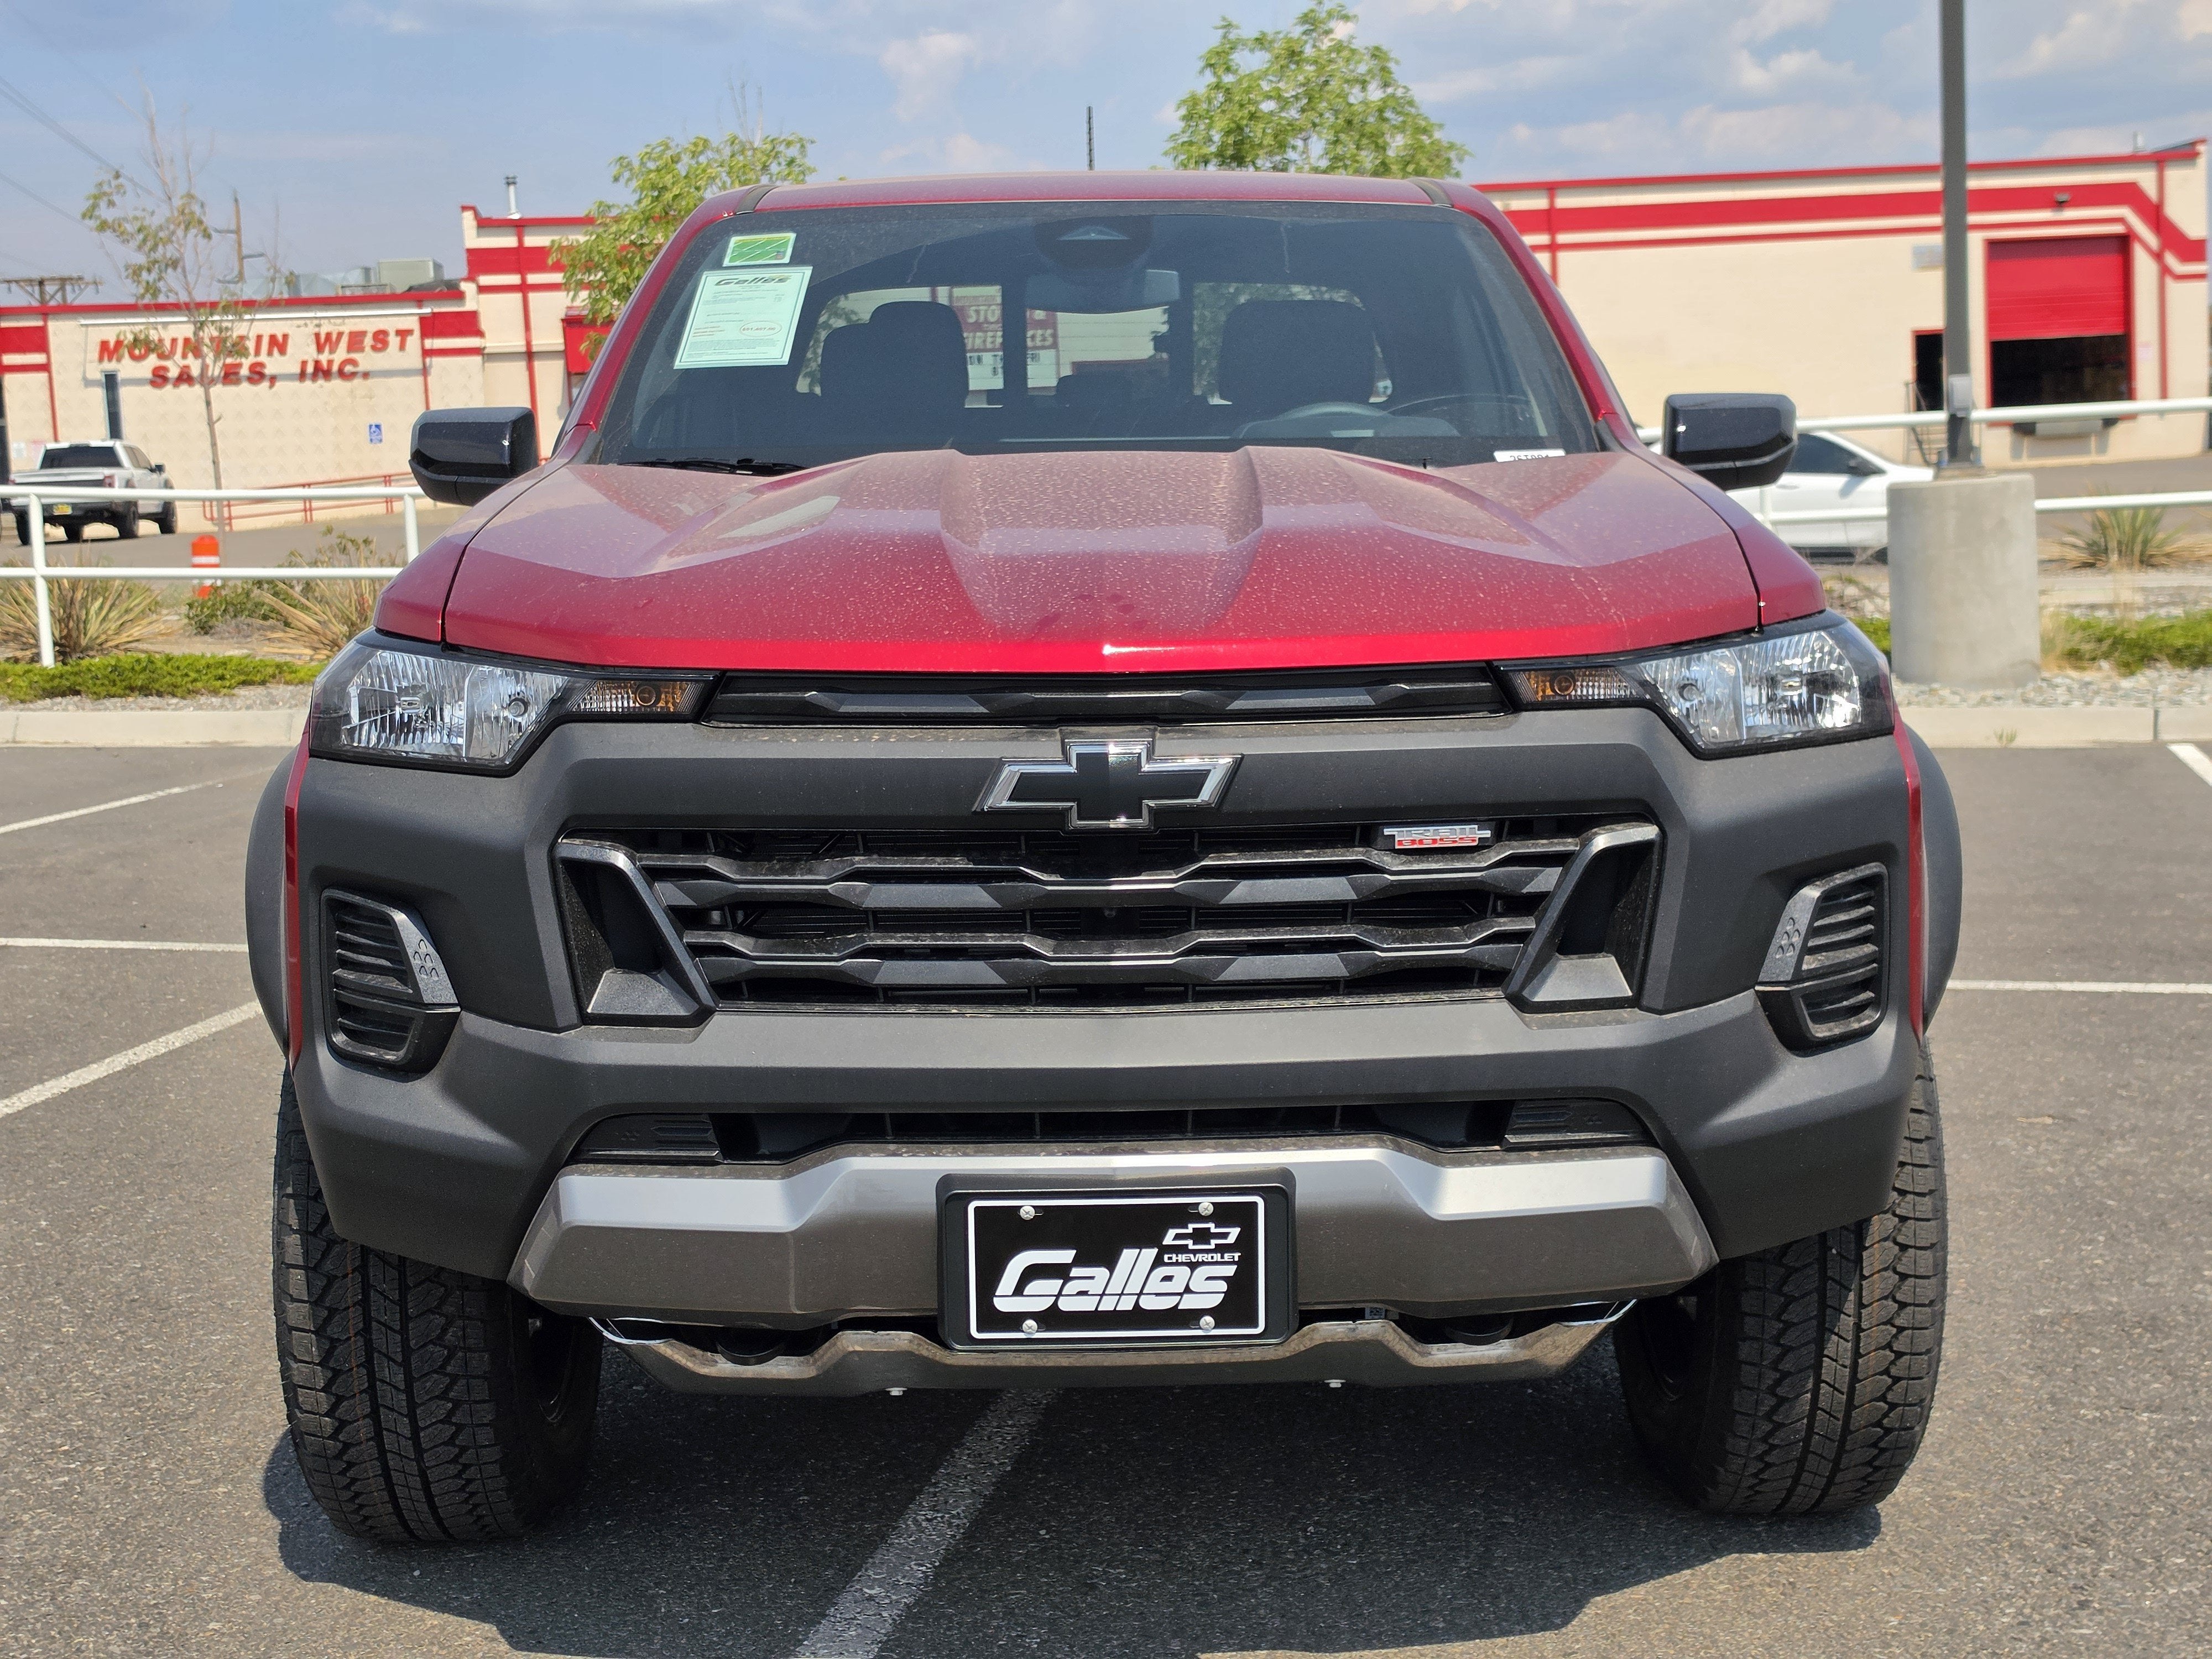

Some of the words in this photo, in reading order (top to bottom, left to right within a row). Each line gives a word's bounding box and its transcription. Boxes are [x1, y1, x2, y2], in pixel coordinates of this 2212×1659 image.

[314, 328, 414, 354] WEST
[299, 357, 370, 383] INC.
[1384, 825, 1491, 839] TRAIL
[1395, 836, 1478, 849] BOSS
[1164, 1252, 1241, 1262] CHEVROLET
[993, 1248, 1238, 1312] Galles
